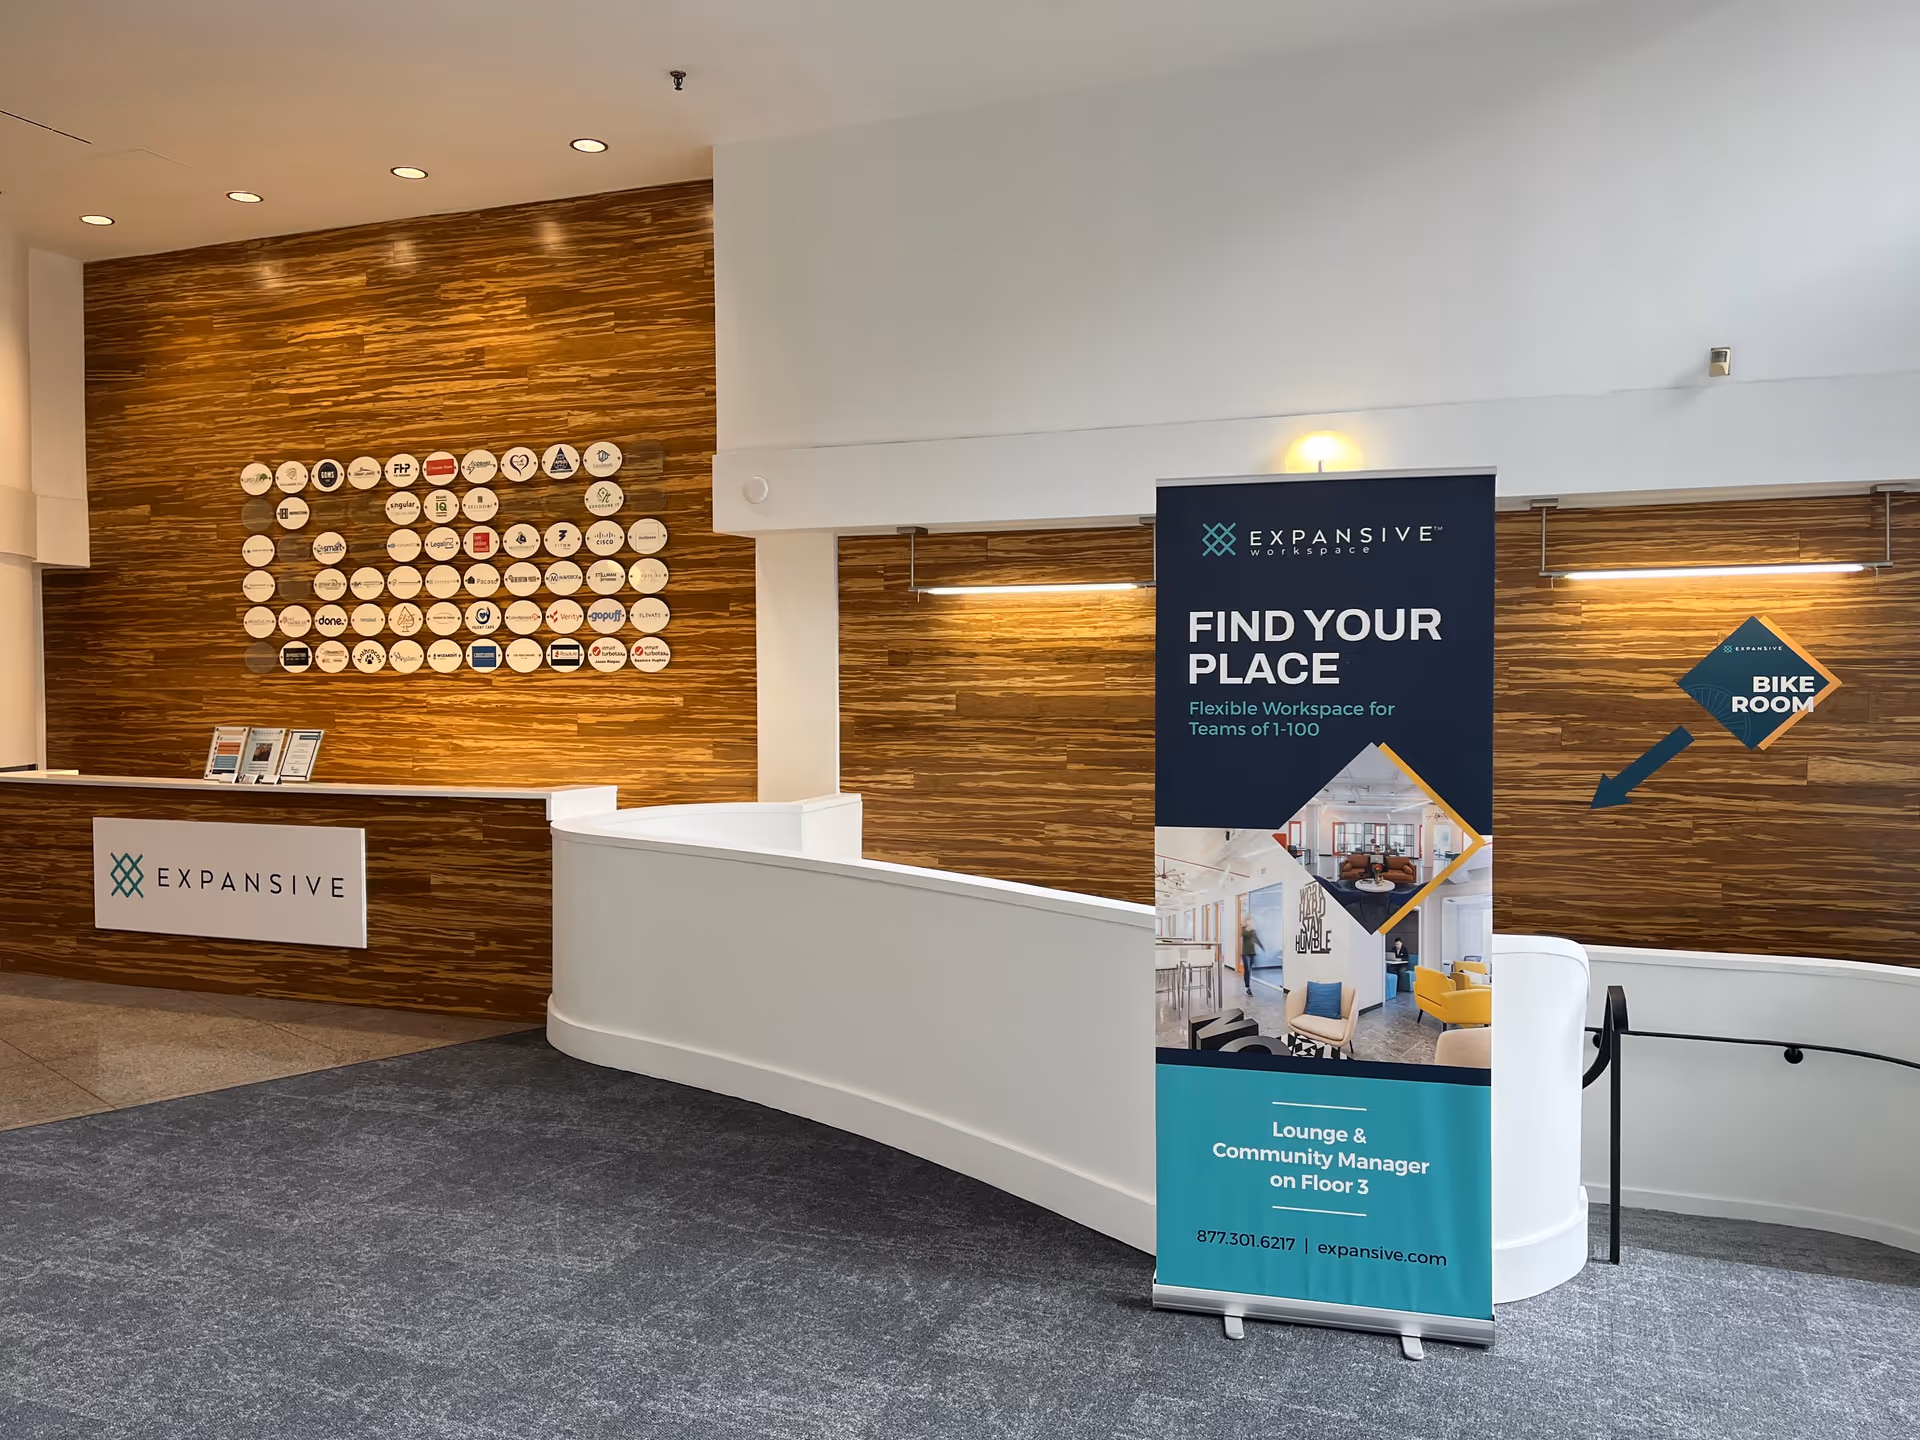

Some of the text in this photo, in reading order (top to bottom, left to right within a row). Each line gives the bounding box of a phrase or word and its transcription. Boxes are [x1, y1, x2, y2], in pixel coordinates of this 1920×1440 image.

[1250, 545, 1370, 556] workspace
[318, 615, 344, 625] done.
[591, 610, 622, 622] gopuff
[1189, 608, 1442, 642] FIND YOUR
[1189, 652, 1340, 684] PLACE
[1752, 676, 1815, 692] BIKE
[1190, 701, 1396, 719] Flexible Workspace for
[1732, 696, 1815, 713] ROOM
[1189, 722, 1320, 737] Teams of 1-100
[158, 868, 344, 898] EXPANSIVE
[1272, 1122, 1367, 1145] Lounge &
[1212, 1142, 1430, 1176] Community Manager
[1270, 1174, 1369, 1195] on Floor 3
[1197, 1230, 1447, 1266] 877.301.6217 expansive.com
